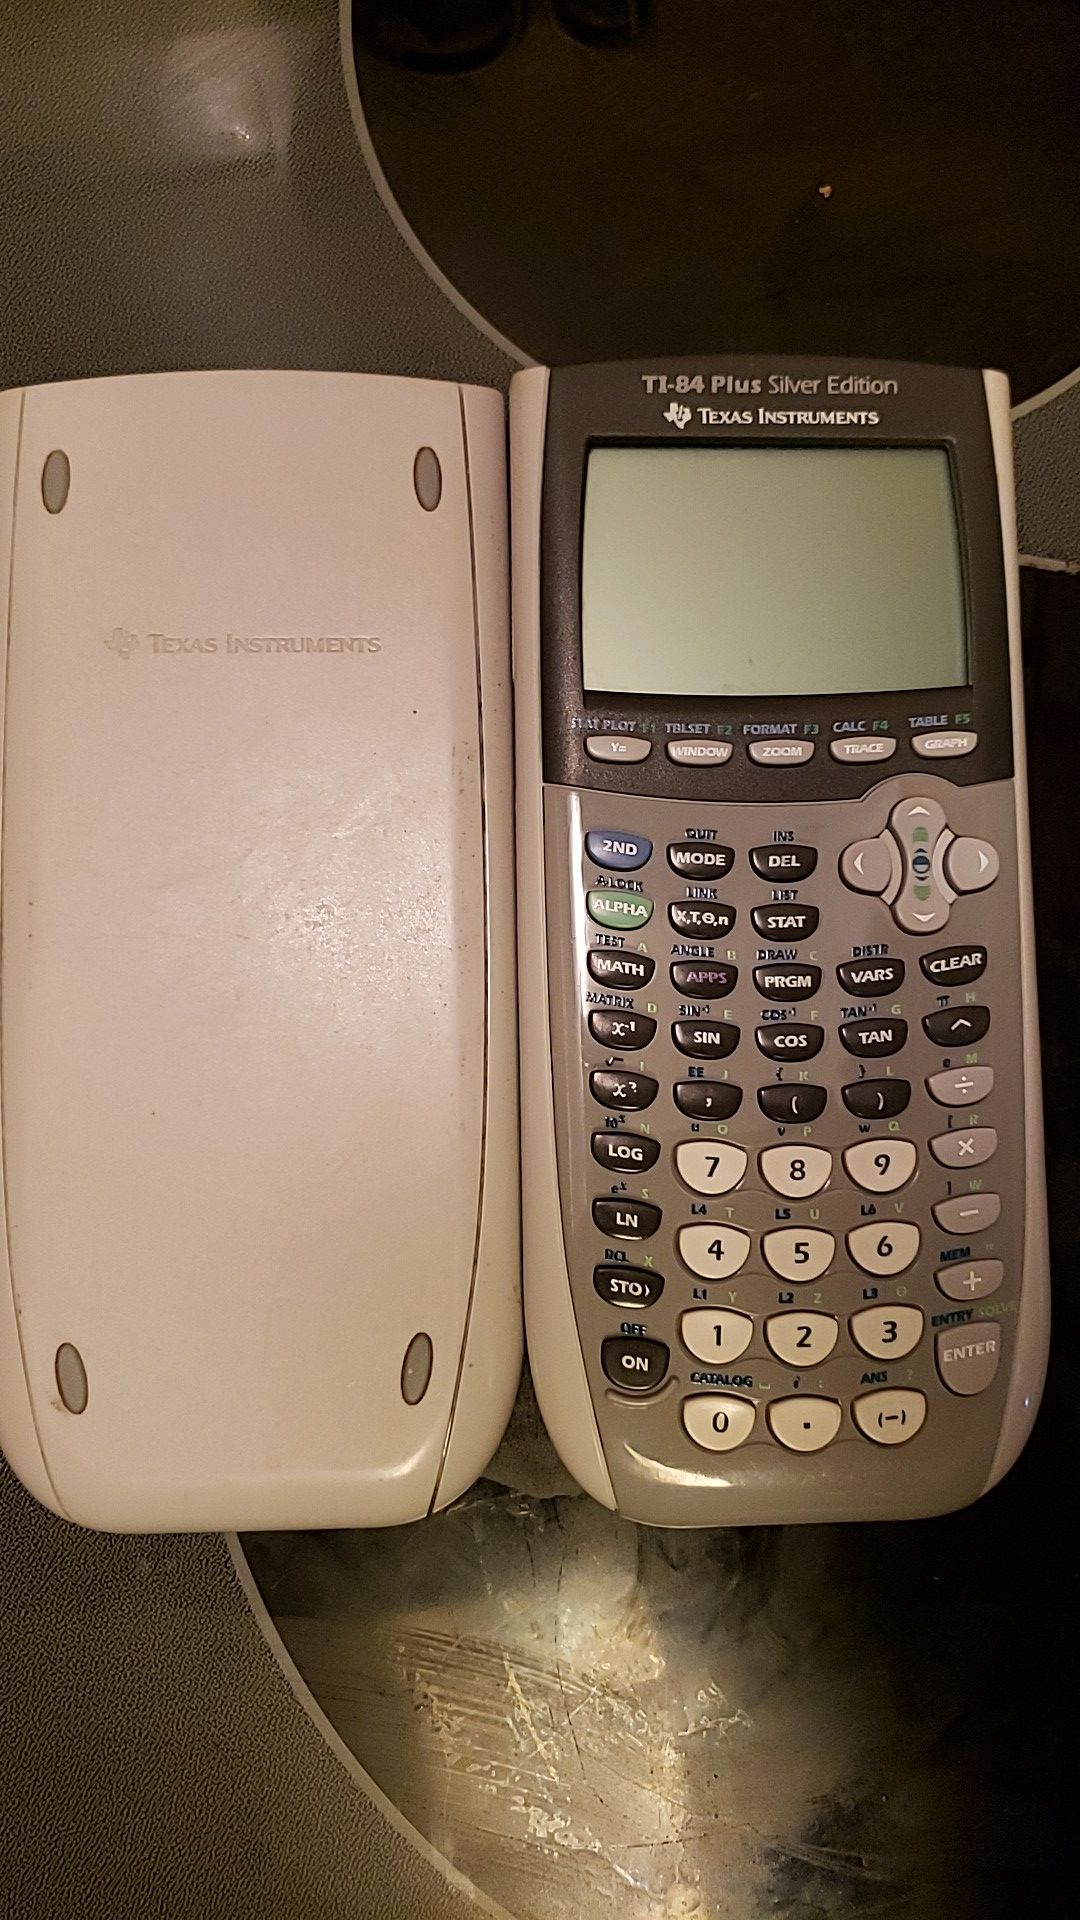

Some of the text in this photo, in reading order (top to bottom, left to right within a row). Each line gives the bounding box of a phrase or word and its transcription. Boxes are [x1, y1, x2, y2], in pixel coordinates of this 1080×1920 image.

[641, 375, 898, 396] TI-84 Plus Silver Edition
[697, 407, 880, 425] TEXAS INSTRUMENTS
[147, 633, 382, 654] TEXAS INSTRUMENTS
[603, 719, 637, 732] PLOT
[833, 720, 889, 733] CALC F4
[909, 713, 971, 728] TABLE F5
[665, 722, 733, 735] TBLSET F2
[743, 723, 819, 735] FORMAT F3
[610, 742, 627, 753] Y=
[672, 746, 729, 758] WINDOW
[762, 746, 803, 757] ZOOM
[844, 743, 884, 754] TRACE
[685, 828, 718, 842] QUIT
[773, 830, 795, 842] INS
[602, 839, 638, 856] 2ND
[676, 851, 727, 867] MODE
[768, 854, 801, 868] DEL
[686, 886, 718, 900] LINK
[771, 889, 799, 901] LIST
[592, 899, 648, 918] ALPHA
[767, 915, 806, 929] STAT
[595, 933, 647, 953] TEST A
[671, 944, 737, 961] ANGLE B
[756, 949, 818, 961] DRAW C
[851, 944, 889, 958] DISTR
[596, 958, 645, 977] MATH
[929, 952, 982, 973] CLEAR
[686, 970, 728, 984] APPS
[764, 975, 812, 988] PRGM
[851, 967, 894, 984] VARS
[965, 992, 977, 1003] H
[647, 1003, 657, 1013] D
[723, 1010, 733, 1020] E
[891, 1004, 902, 1015] G
[810, 1010, 819, 1021] F
[693, 1031, 721, 1045] SIN
[774, 1035, 808, 1048] COS
[857, 1029, 893, 1045] TAN
[965, 1053, 978, 1064] M
[688, 1066, 705, 1078] EE
[800, 1071, 809, 1081] K
[886, 1066, 894, 1076] L
[888, 1121, 900, 1132] Q
[969, 1114, 980, 1125] R
[640, 1123, 650, 1135] N
[803, 1126, 812, 1137] P
[608, 1143, 643, 1161] LOG
[705, 1156, 720, 1178] 7
[789, 1159, 806, 1181] 8
[874, 1153, 891, 1176] 9
[969, 1179, 982, 1191] W
[641, 1188, 649, 1200] S
[691, 1203, 735, 1219] L4 T
[775, 1208, 820, 1221] L5 U
[861, 1204, 877, 1216] L6
[616, 1211, 638, 1228] LN
[707, 1239, 725, 1261] 4
[794, 1242, 810, 1264] 5
[877, 1235, 893, 1257] 6
[604, 1248, 654, 1268] RCL X
[939, 1246, 971, 1262] MEM
[693, 1287, 737, 1303] L1 Y
[778, 1292, 822, 1304] L2 Z
[862, 1287, 879, 1300] L3
[931, 1308, 974, 1328] ENTRY
[620, 1322, 648, 1336] OFF
[713, 1324, 722, 1347] 1
[881, 1320, 898, 1344] 3
[796, 1326, 812, 1348] 2
[943, 1339, 996, 1362] ENTER
[621, 1355, 649, 1372] ON
[690, 1371, 753, 1388] CATALOG
[860, 1371, 888, 1385] ANS
[712, 1411, 729, 1434] 0
